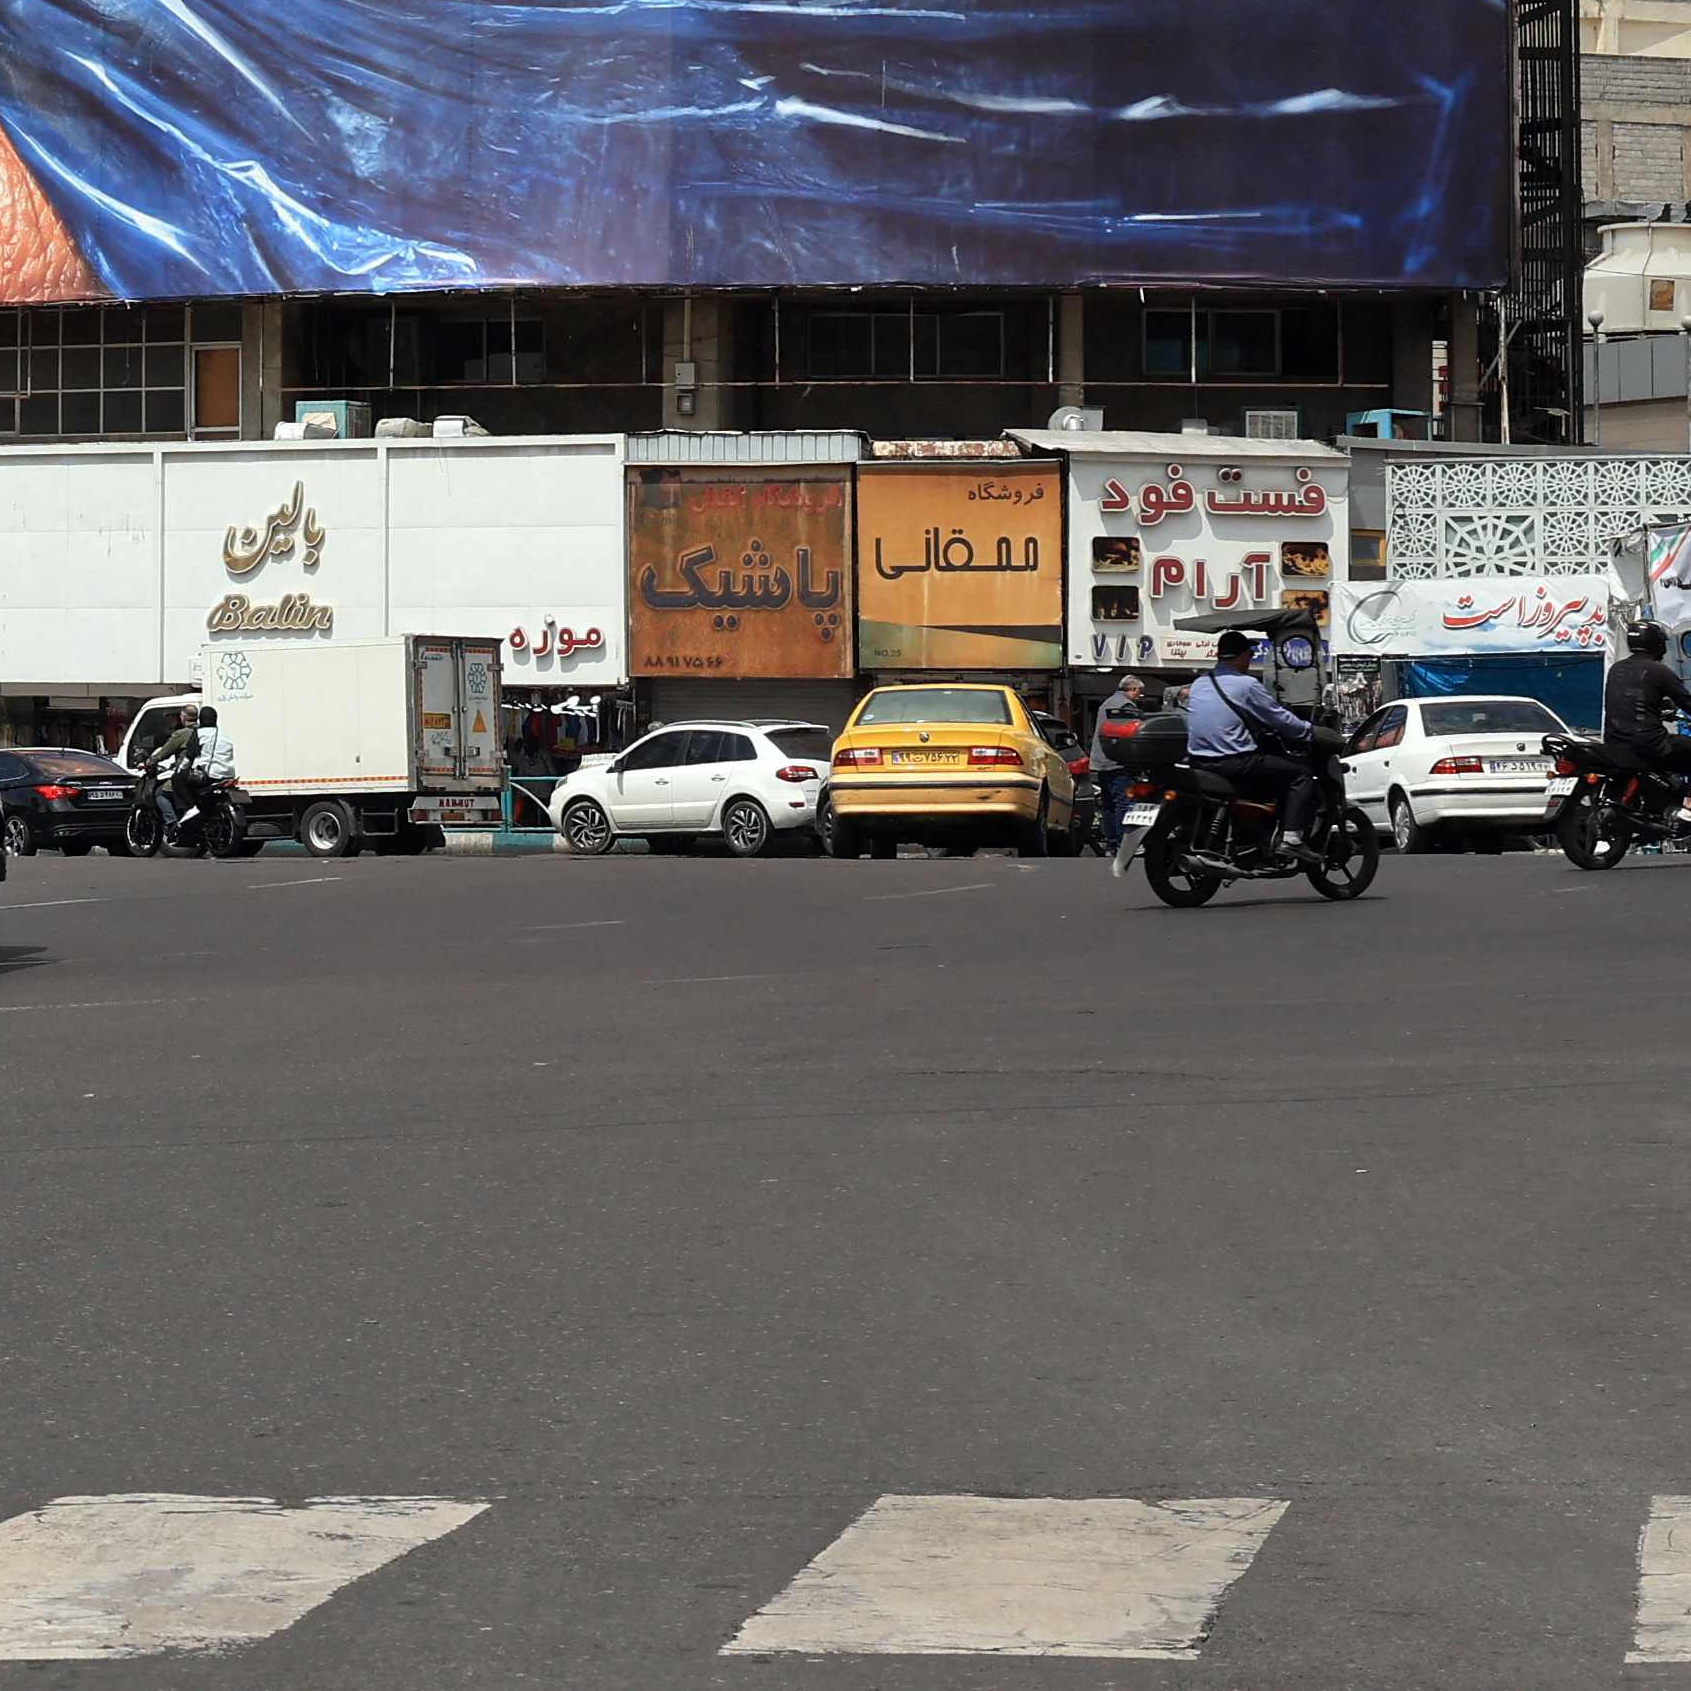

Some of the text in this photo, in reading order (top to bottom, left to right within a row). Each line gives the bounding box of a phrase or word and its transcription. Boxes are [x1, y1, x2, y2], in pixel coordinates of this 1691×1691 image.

[968, 482, 1045, 506] فروشگاه
[1100, 463, 1328, 526] فست فود
[222, 480, 327, 574] بالین
[874, 526, 1039, 580] ممقانی
[1150, 550, 1272, 610] آرام
[207, 593, 334, 632] Balin
[509, 614, 603, 658] موزه
[1092, 634, 1154, 660] VIP
